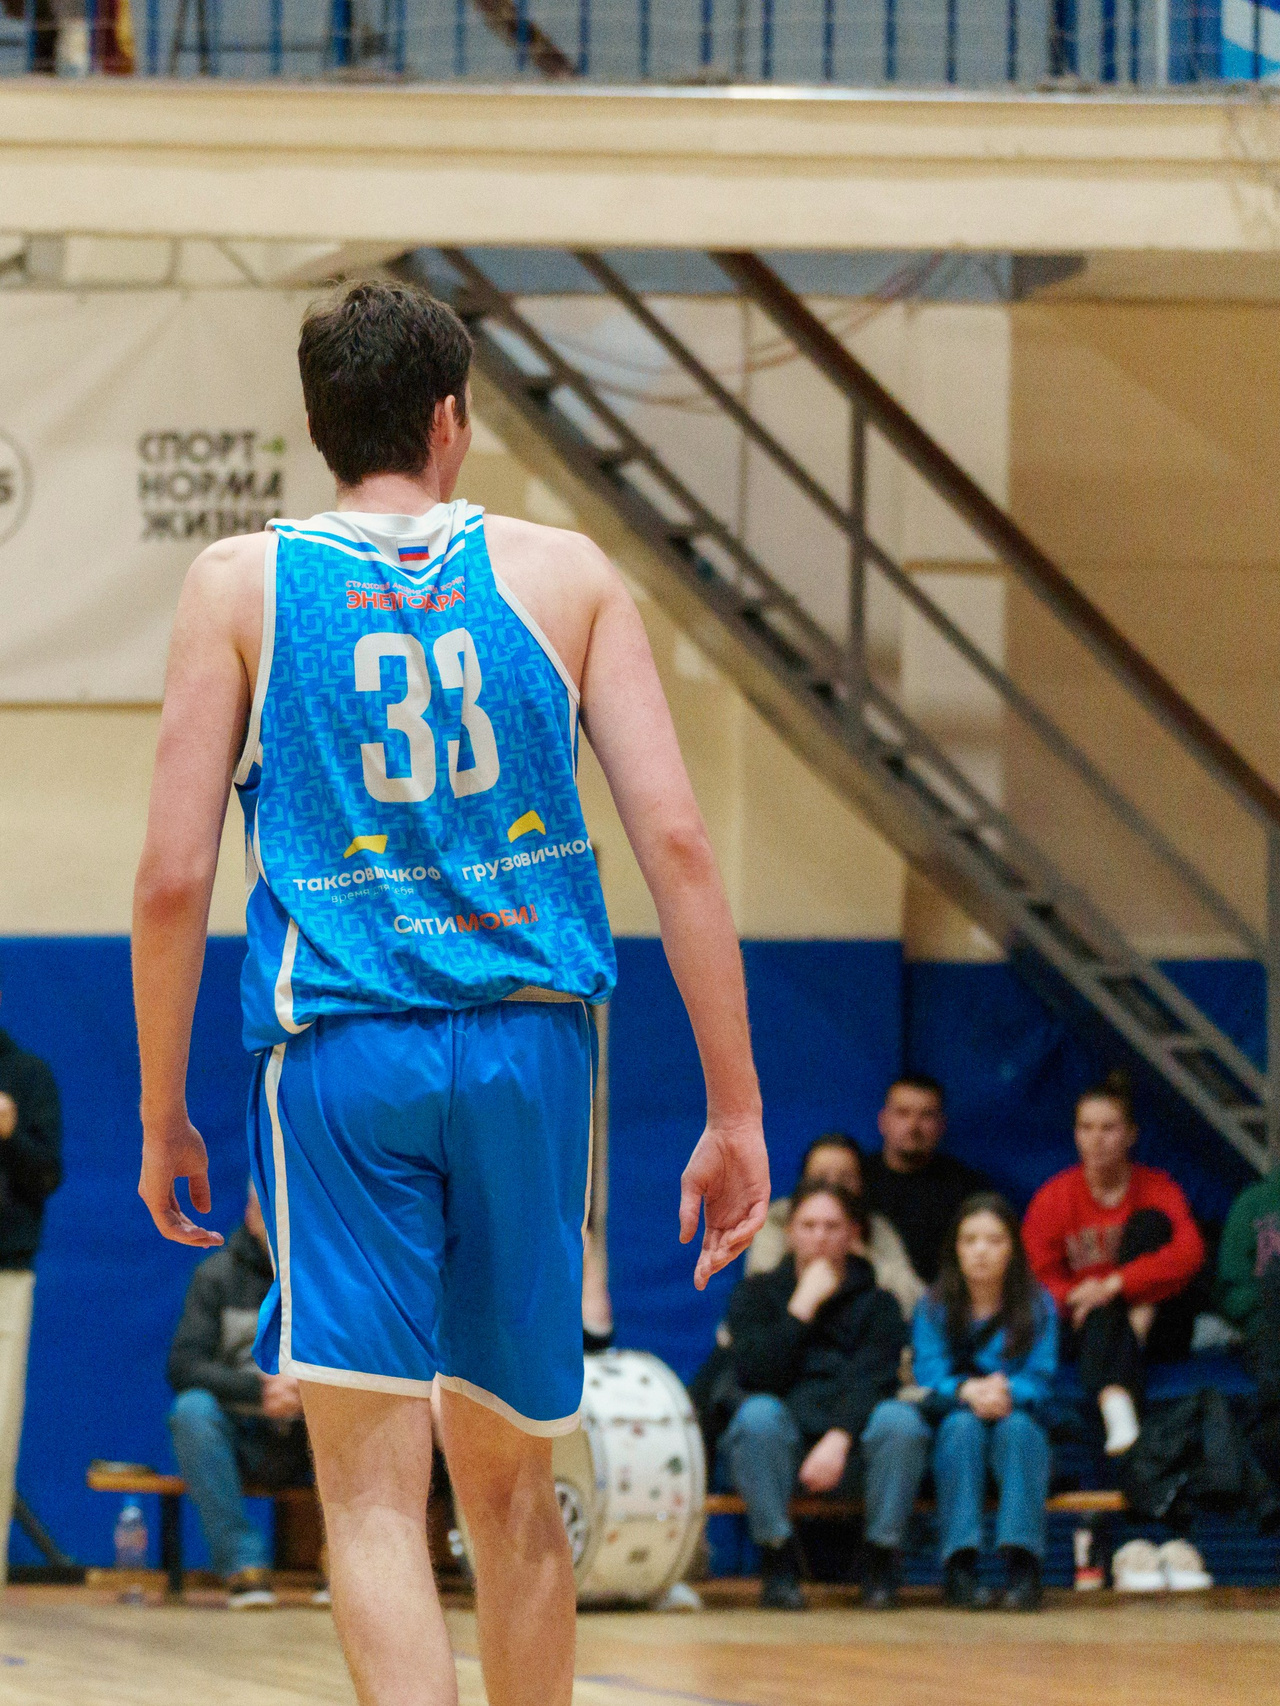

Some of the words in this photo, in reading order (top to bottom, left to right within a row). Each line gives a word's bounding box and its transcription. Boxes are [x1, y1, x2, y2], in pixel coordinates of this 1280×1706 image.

[138, 430, 257, 464] СПОРТ
[138, 469, 283, 502] НОРМА
[142, 508, 281, 542] ЖИЗН
[353, 627, 500, 803] 33
[331, 888, 370, 904] время
[391, 885, 415, 896] ебя
